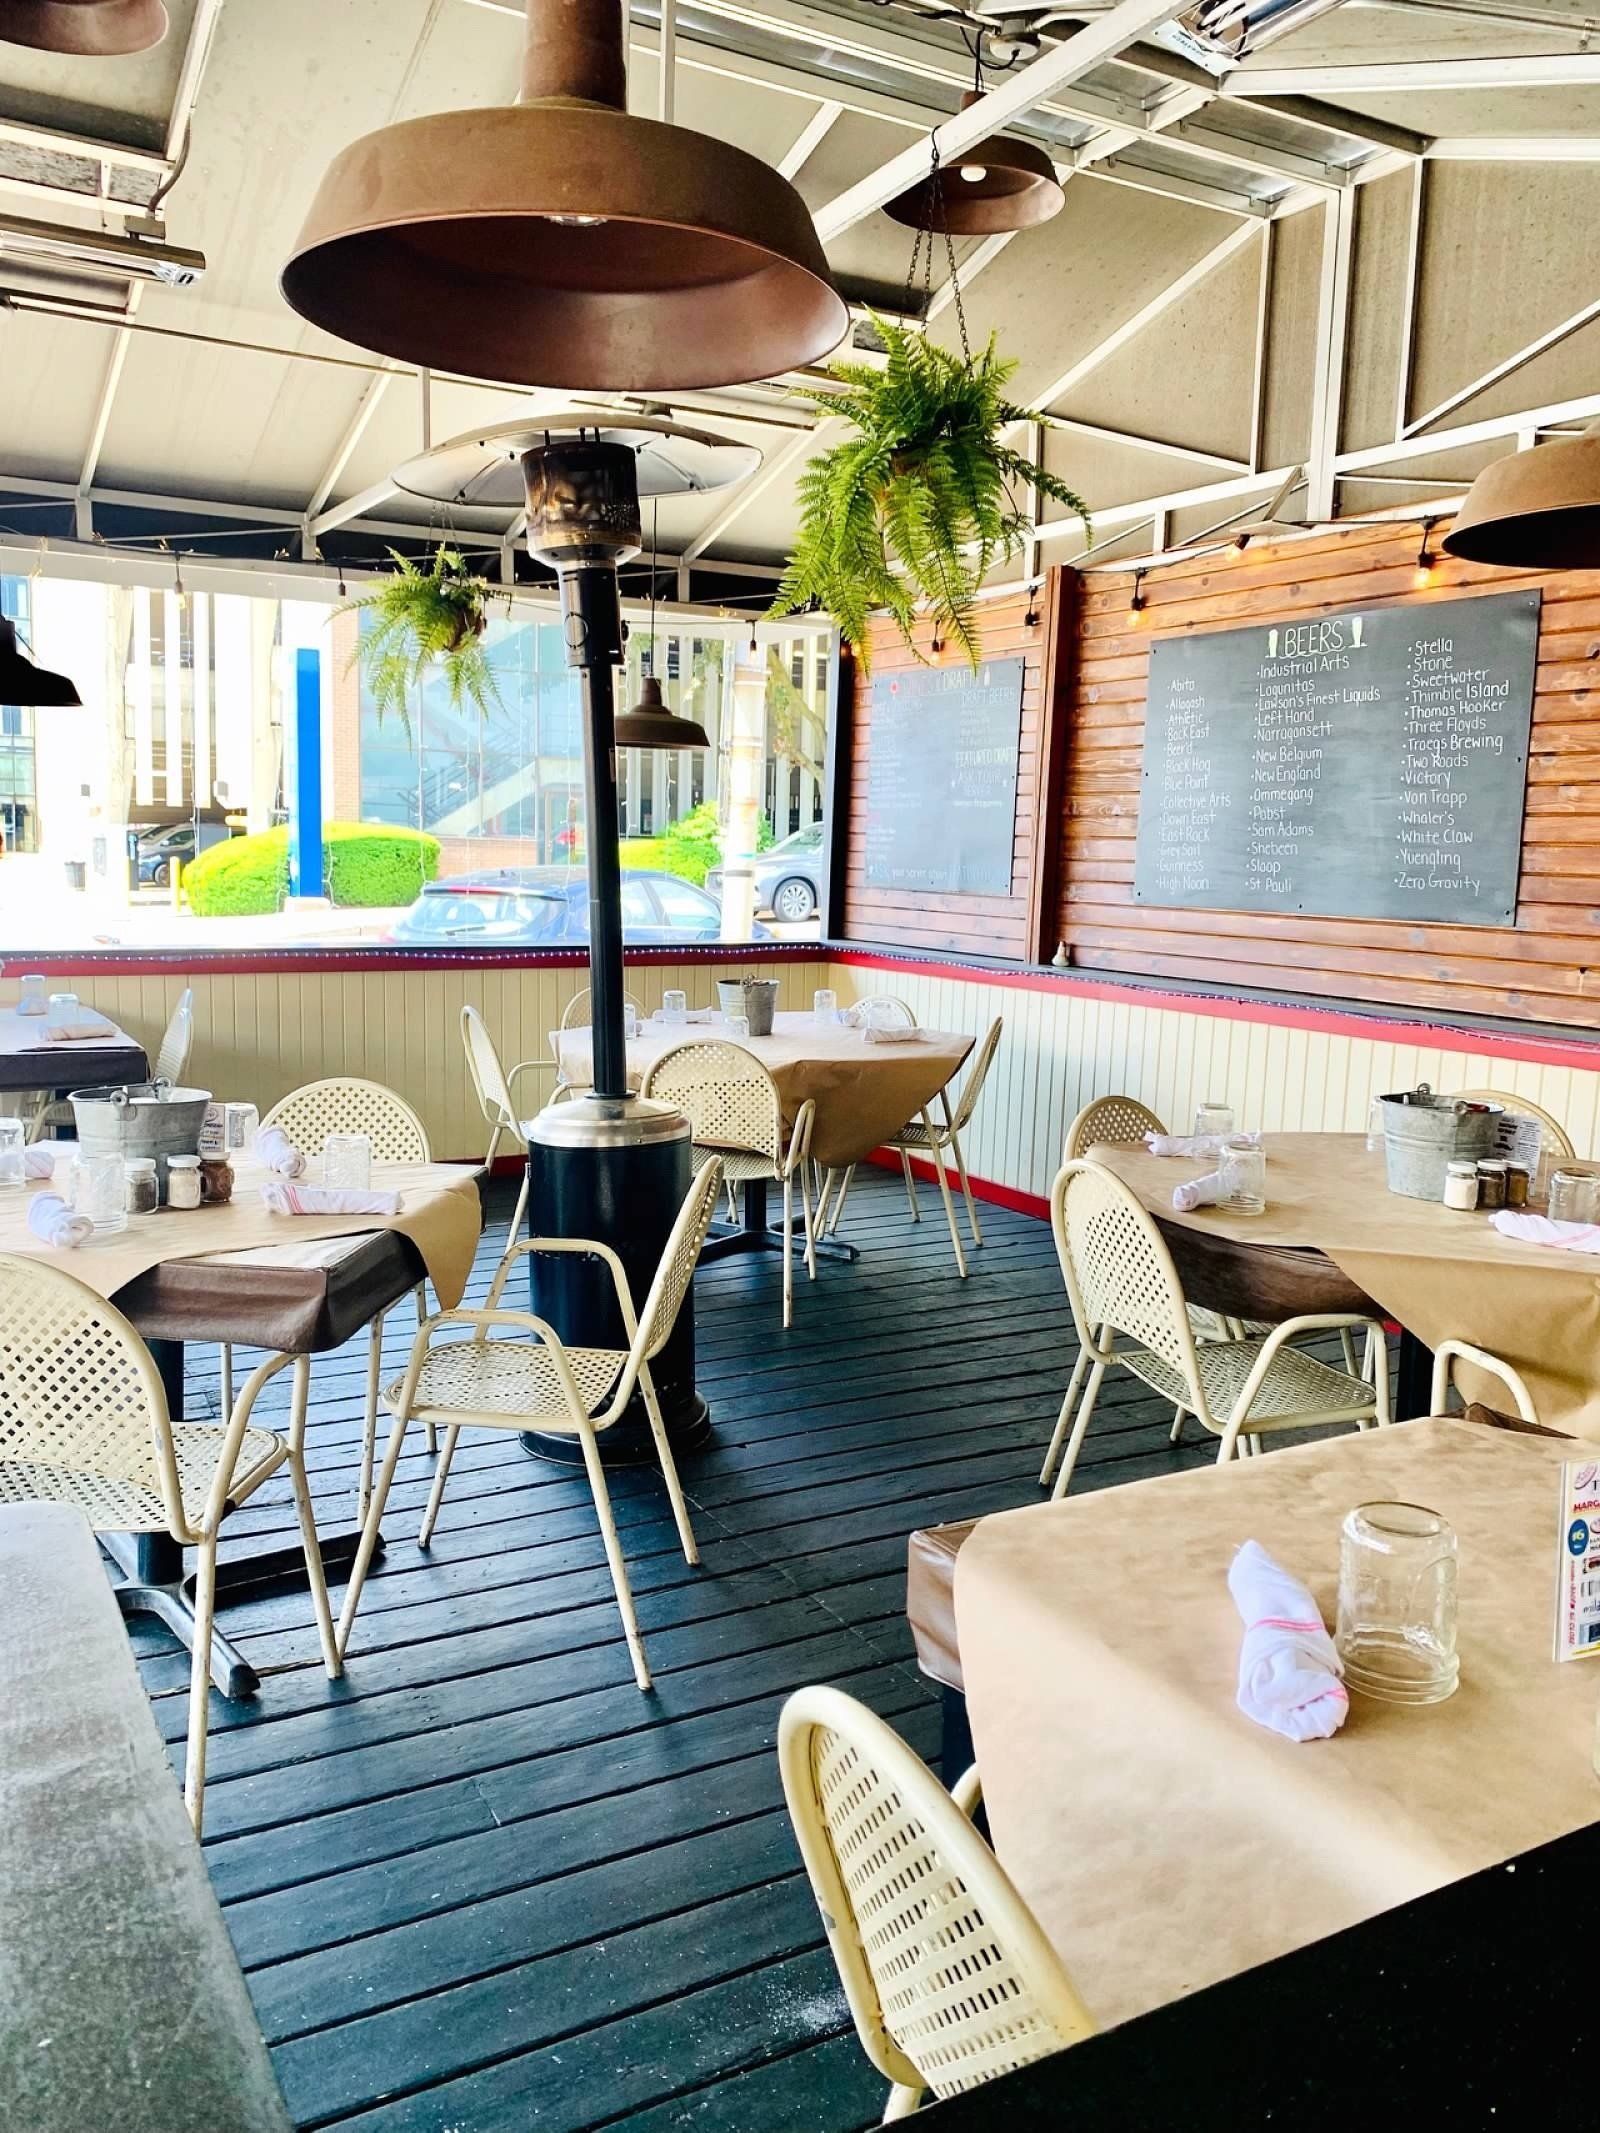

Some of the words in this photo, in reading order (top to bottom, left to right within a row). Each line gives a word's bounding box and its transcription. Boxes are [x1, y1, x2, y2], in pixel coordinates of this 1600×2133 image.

[1284, 620, 1344, 656] BEERS
[1415, 638, 1452, 656] Stella
[1260, 657, 1317, 678] Industrial
[1320, 654, 1350, 672] Arts
[1414, 655, 1452, 672] Stone
[1412, 668, 1490, 688] Sweetwater
[1260, 679, 1315, 699] Lagunitas
[1260, 695, 1304, 711] Lawson's
[1307, 690, 1340, 706] Finest
[1343, 685, 1381, 707] Liquids
[1411, 686, 1462, 703] Thimble
[1466, 679, 1510, 699] Island
[1258, 709, 1283, 726] Left
[1286, 706, 1315, 724] Hand
[1410, 705, 1456, 720] Thomas
[1257, 720, 1334, 746] Narragansett
[1408, 720, 1443, 734] Three
[1446, 715, 1487, 735] Floyds
[1450, 733, 1504, 756] Brewing
[1255, 749, 1277, 763] New
[1279, 745, 1323, 766] Belgium
[1407, 754, 1429, 768] Two
[1430, 752, 1469, 768] Roads
[1254, 767, 1275, 782] New
[1276, 762, 1321, 787] England
[1404, 770, 1451, 790] Victory
[1254, 787, 1314, 806] Ommegang
[1404, 791, 1428, 805] Von
[1430, 788, 1468, 809] Trapp
[1253, 805, 1287, 821] Pabst
[1402, 810, 1455, 826] Whaler's
[1252, 821, 1275, 837] Sam
[1277, 820, 1314, 837] Adams
[1401, 829, 1440, 845] White
[1443, 828, 1474, 844] Claw
[1400, 848, 1461, 874] Yuengling
[1249, 877, 1261, 890] St
[1265, 877, 1293, 893] Pauli
[1399, 871, 1426, 891] Zero
[1428, 872, 1480, 896] Gravity
